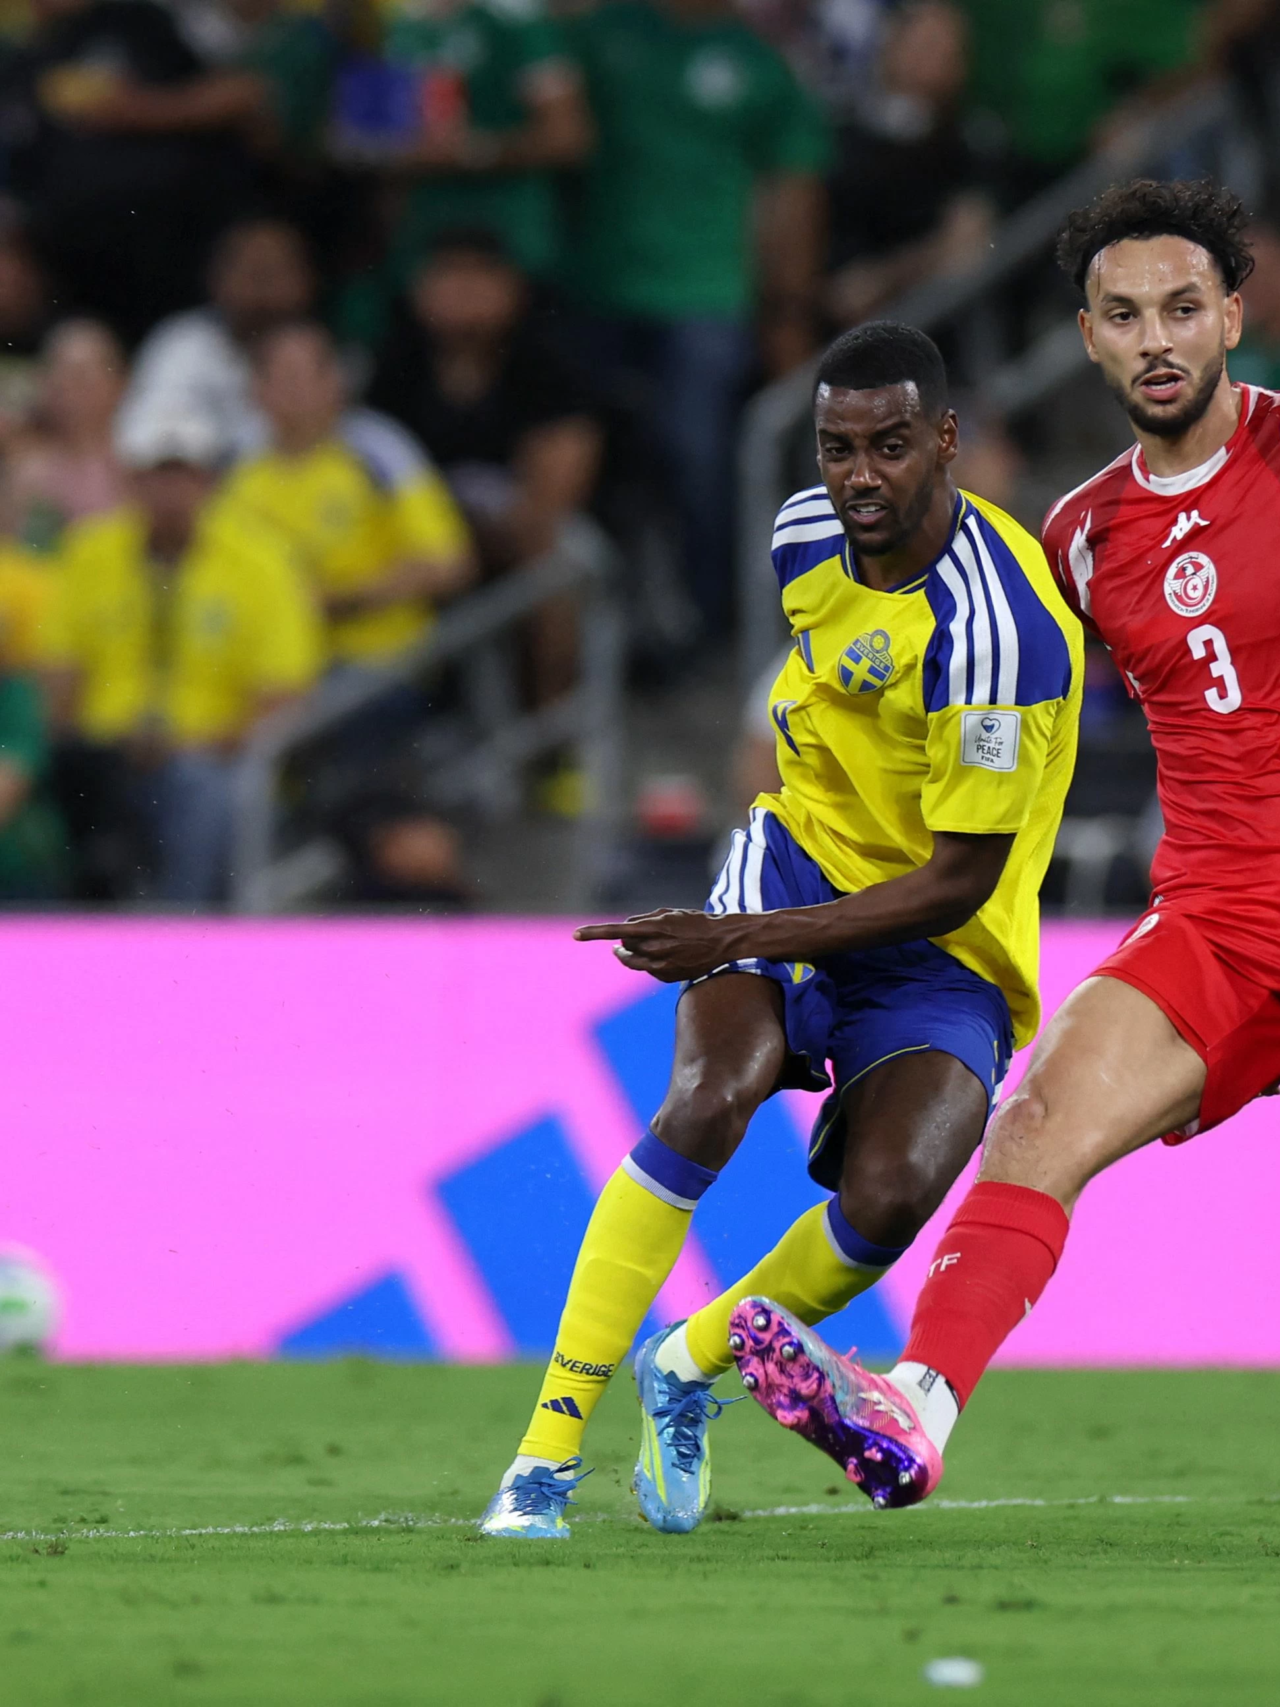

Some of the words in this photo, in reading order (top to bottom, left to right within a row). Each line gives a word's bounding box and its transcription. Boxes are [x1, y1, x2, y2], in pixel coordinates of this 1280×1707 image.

[855, 641, 887, 670] SVERIGE
[1186, 623, 1243, 715] 3
[976, 744, 1002, 759] PEACE
[929, 1252, 961, 1278] TF
